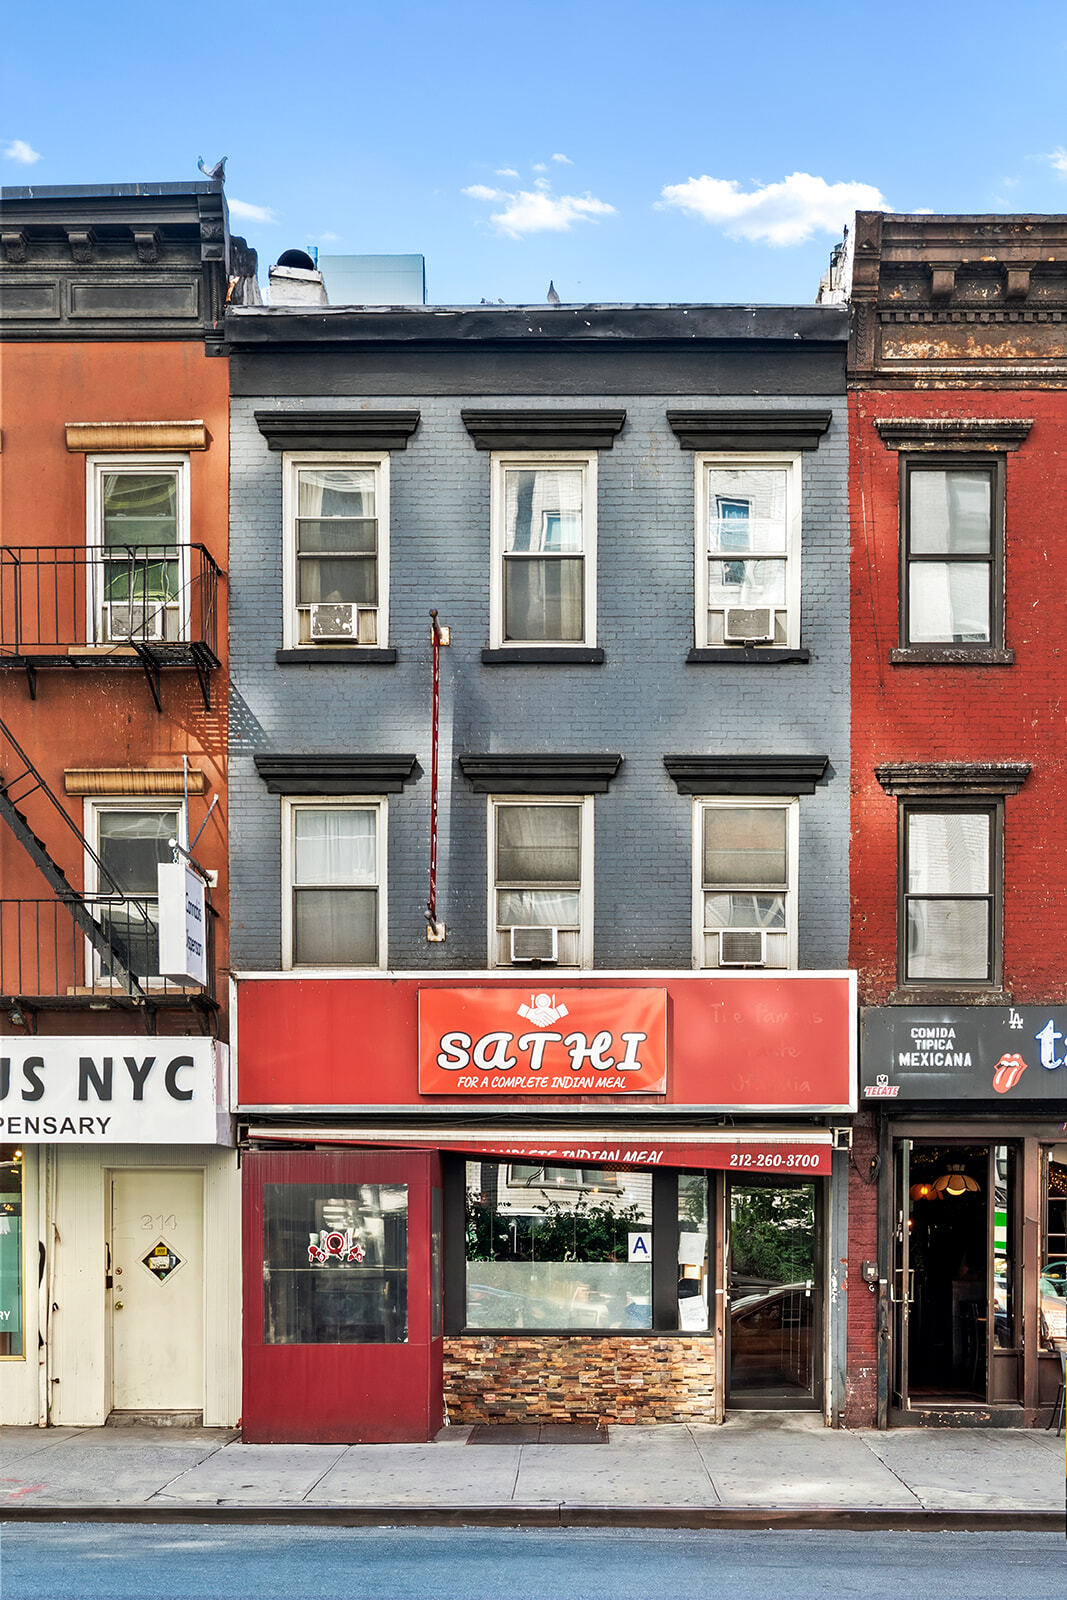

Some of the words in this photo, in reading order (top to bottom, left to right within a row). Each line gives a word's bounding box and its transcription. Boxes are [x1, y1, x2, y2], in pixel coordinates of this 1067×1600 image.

[911, 1027, 956, 1039] COMIDA
[914, 1039, 954, 1051] TIPICA
[1035, 1019, 1067, 1070] t
[898, 1052, 972, 1067] MEXICANA
[78, 1056, 194, 1101] NYC
[457, 1076, 479, 1088] FOR
[480, 1076, 489, 1088] A
[491, 1076, 549, 1089] COMPLETE
[551, 1076, 594, 1089] INDIAN
[596, 1076, 626, 1089] MEAL
[864, 1086, 900, 1097] TECATE
[729, 1153, 820, 1167] 212-260-3700
[141, 1214, 177, 1230] 214
[633, 1236, 648, 1254] A
